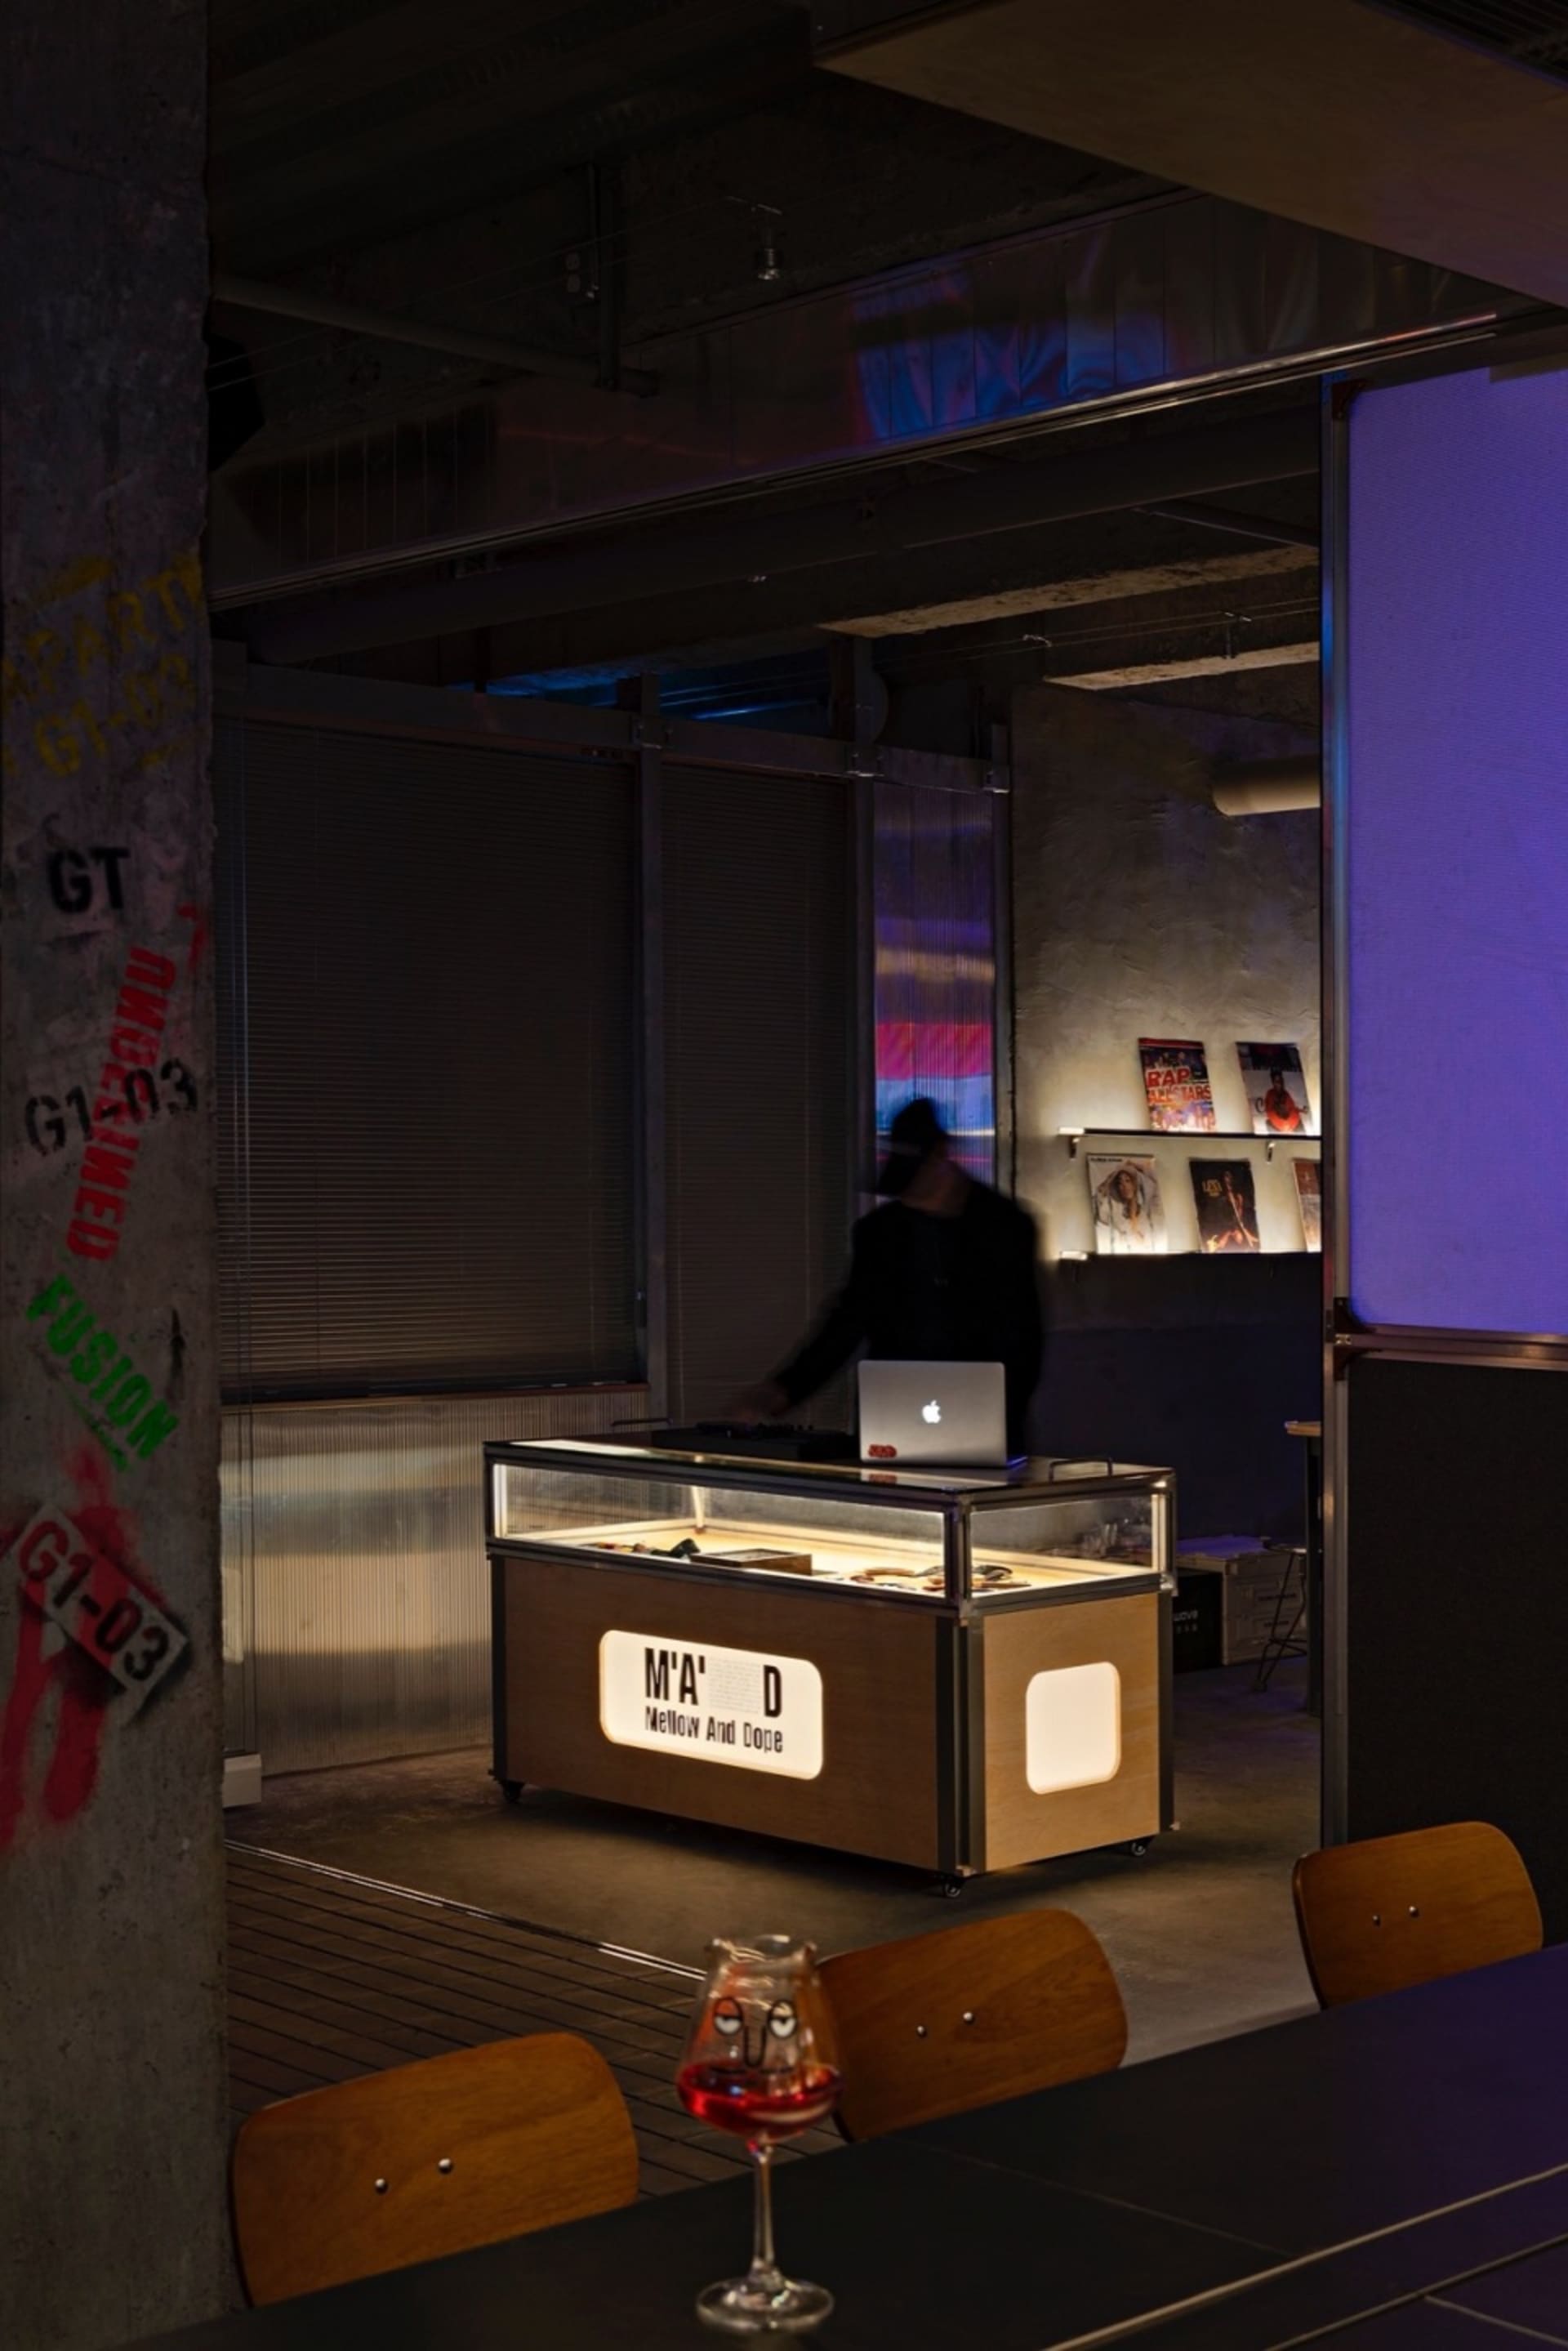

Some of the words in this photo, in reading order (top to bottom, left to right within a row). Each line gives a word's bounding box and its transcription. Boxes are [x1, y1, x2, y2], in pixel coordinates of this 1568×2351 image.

[50, 848, 131, 914] GT
[25, 1059, 198, 1155] G1-03
[1147, 1068, 1191, 1087] RAP
[29, 1276, 179, 1460] FUSION
[19, 1520, 170, 1680] G1-03
[645, 1706, 700, 1739] Mellow
[706, 1716, 735, 1745] And
[743, 1723, 783, 1754] Dope
